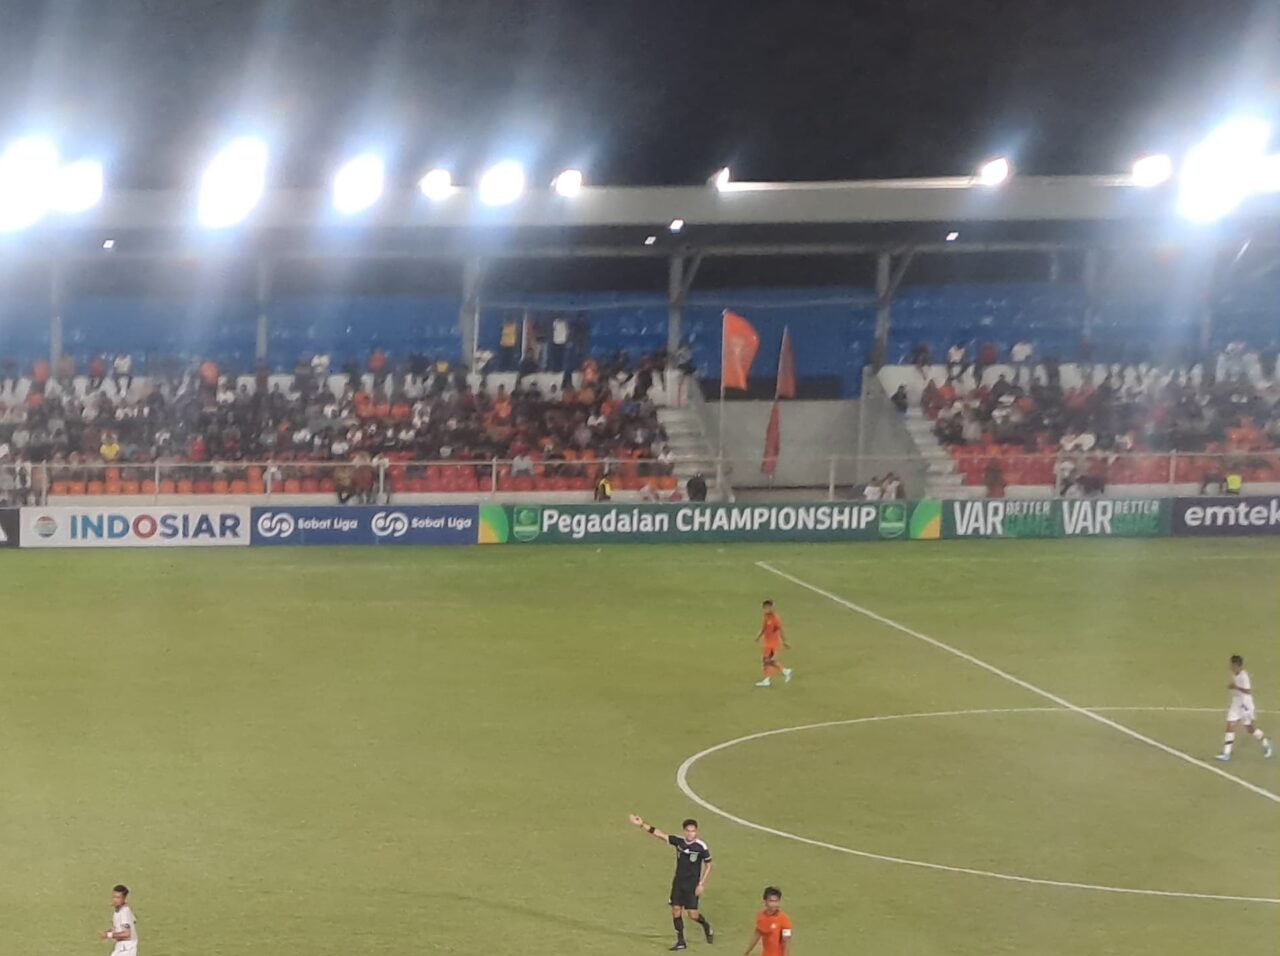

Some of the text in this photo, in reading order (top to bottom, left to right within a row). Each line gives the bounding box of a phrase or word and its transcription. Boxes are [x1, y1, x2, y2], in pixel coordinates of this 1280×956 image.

[70, 514, 241, 540] INDOSIAR
[298, 518, 358, 531] Sobat Liga
[411, 517, 472, 530] Sobat Liga
[543, 506, 876, 538] Pegadaian CHAMPIONSHIP
[953, 501, 1004, 535] VAR
[1062, 500, 1113, 534] VAR
[1114, 500, 1159, 514] BETTER
